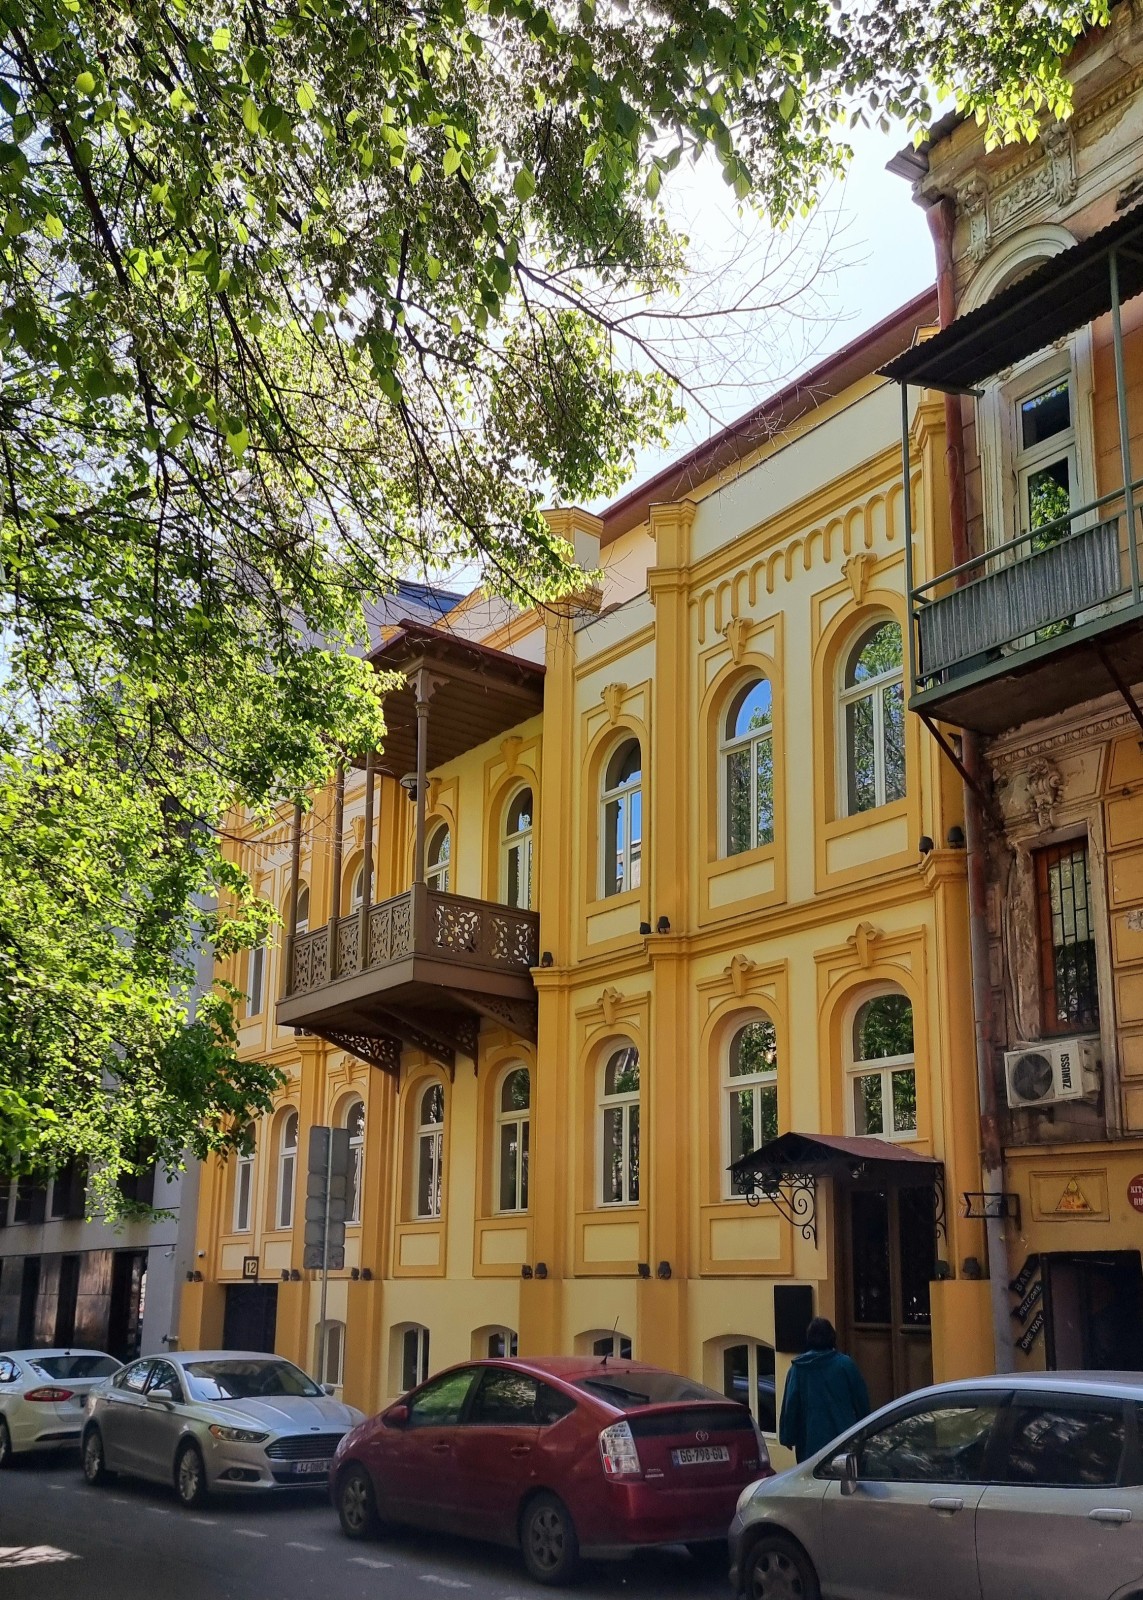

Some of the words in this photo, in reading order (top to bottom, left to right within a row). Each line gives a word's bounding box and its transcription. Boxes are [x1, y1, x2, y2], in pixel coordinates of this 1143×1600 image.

[1060, 1053, 1072, 1090] ZANUSSI
[247, 1261, 257, 1274] 12
[1015, 1269, 1032, 1292] BAR
[1019, 1284, 1042, 1317] WELCOME
[1021, 1332, 1034, 1349] ONE
[1030, 1314, 1044, 1334] WAY
